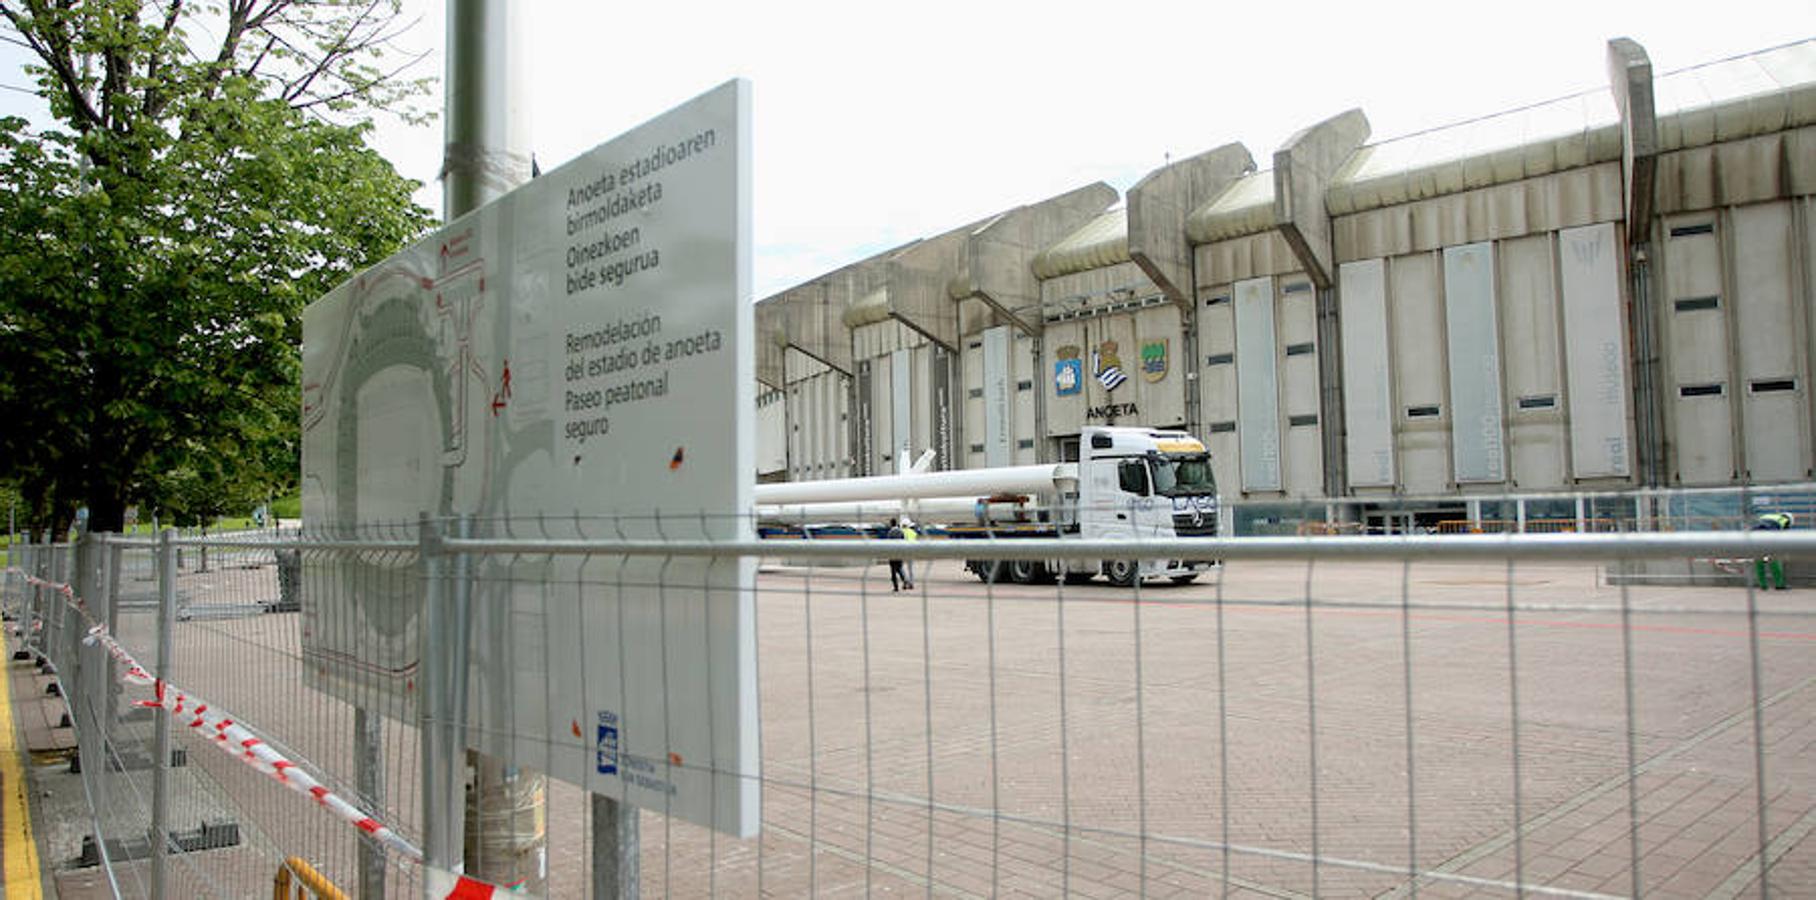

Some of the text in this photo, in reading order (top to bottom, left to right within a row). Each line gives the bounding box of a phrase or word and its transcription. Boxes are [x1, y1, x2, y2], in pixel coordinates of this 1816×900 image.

[567, 129, 715, 209] Anoeta estadioaren
[567, 182, 663, 236] birmoldaketa
[567, 227, 640, 268] Oinezkoen
[567, 249, 659, 295] bide segurua
[566, 314, 661, 353] Remodelación
[565, 330, 721, 382] del estadio de anoeta
[565, 370, 668, 411] Paseo peatonal
[565, 416, 609, 443] seguro
[1086, 403, 1138, 420] ANOETA
